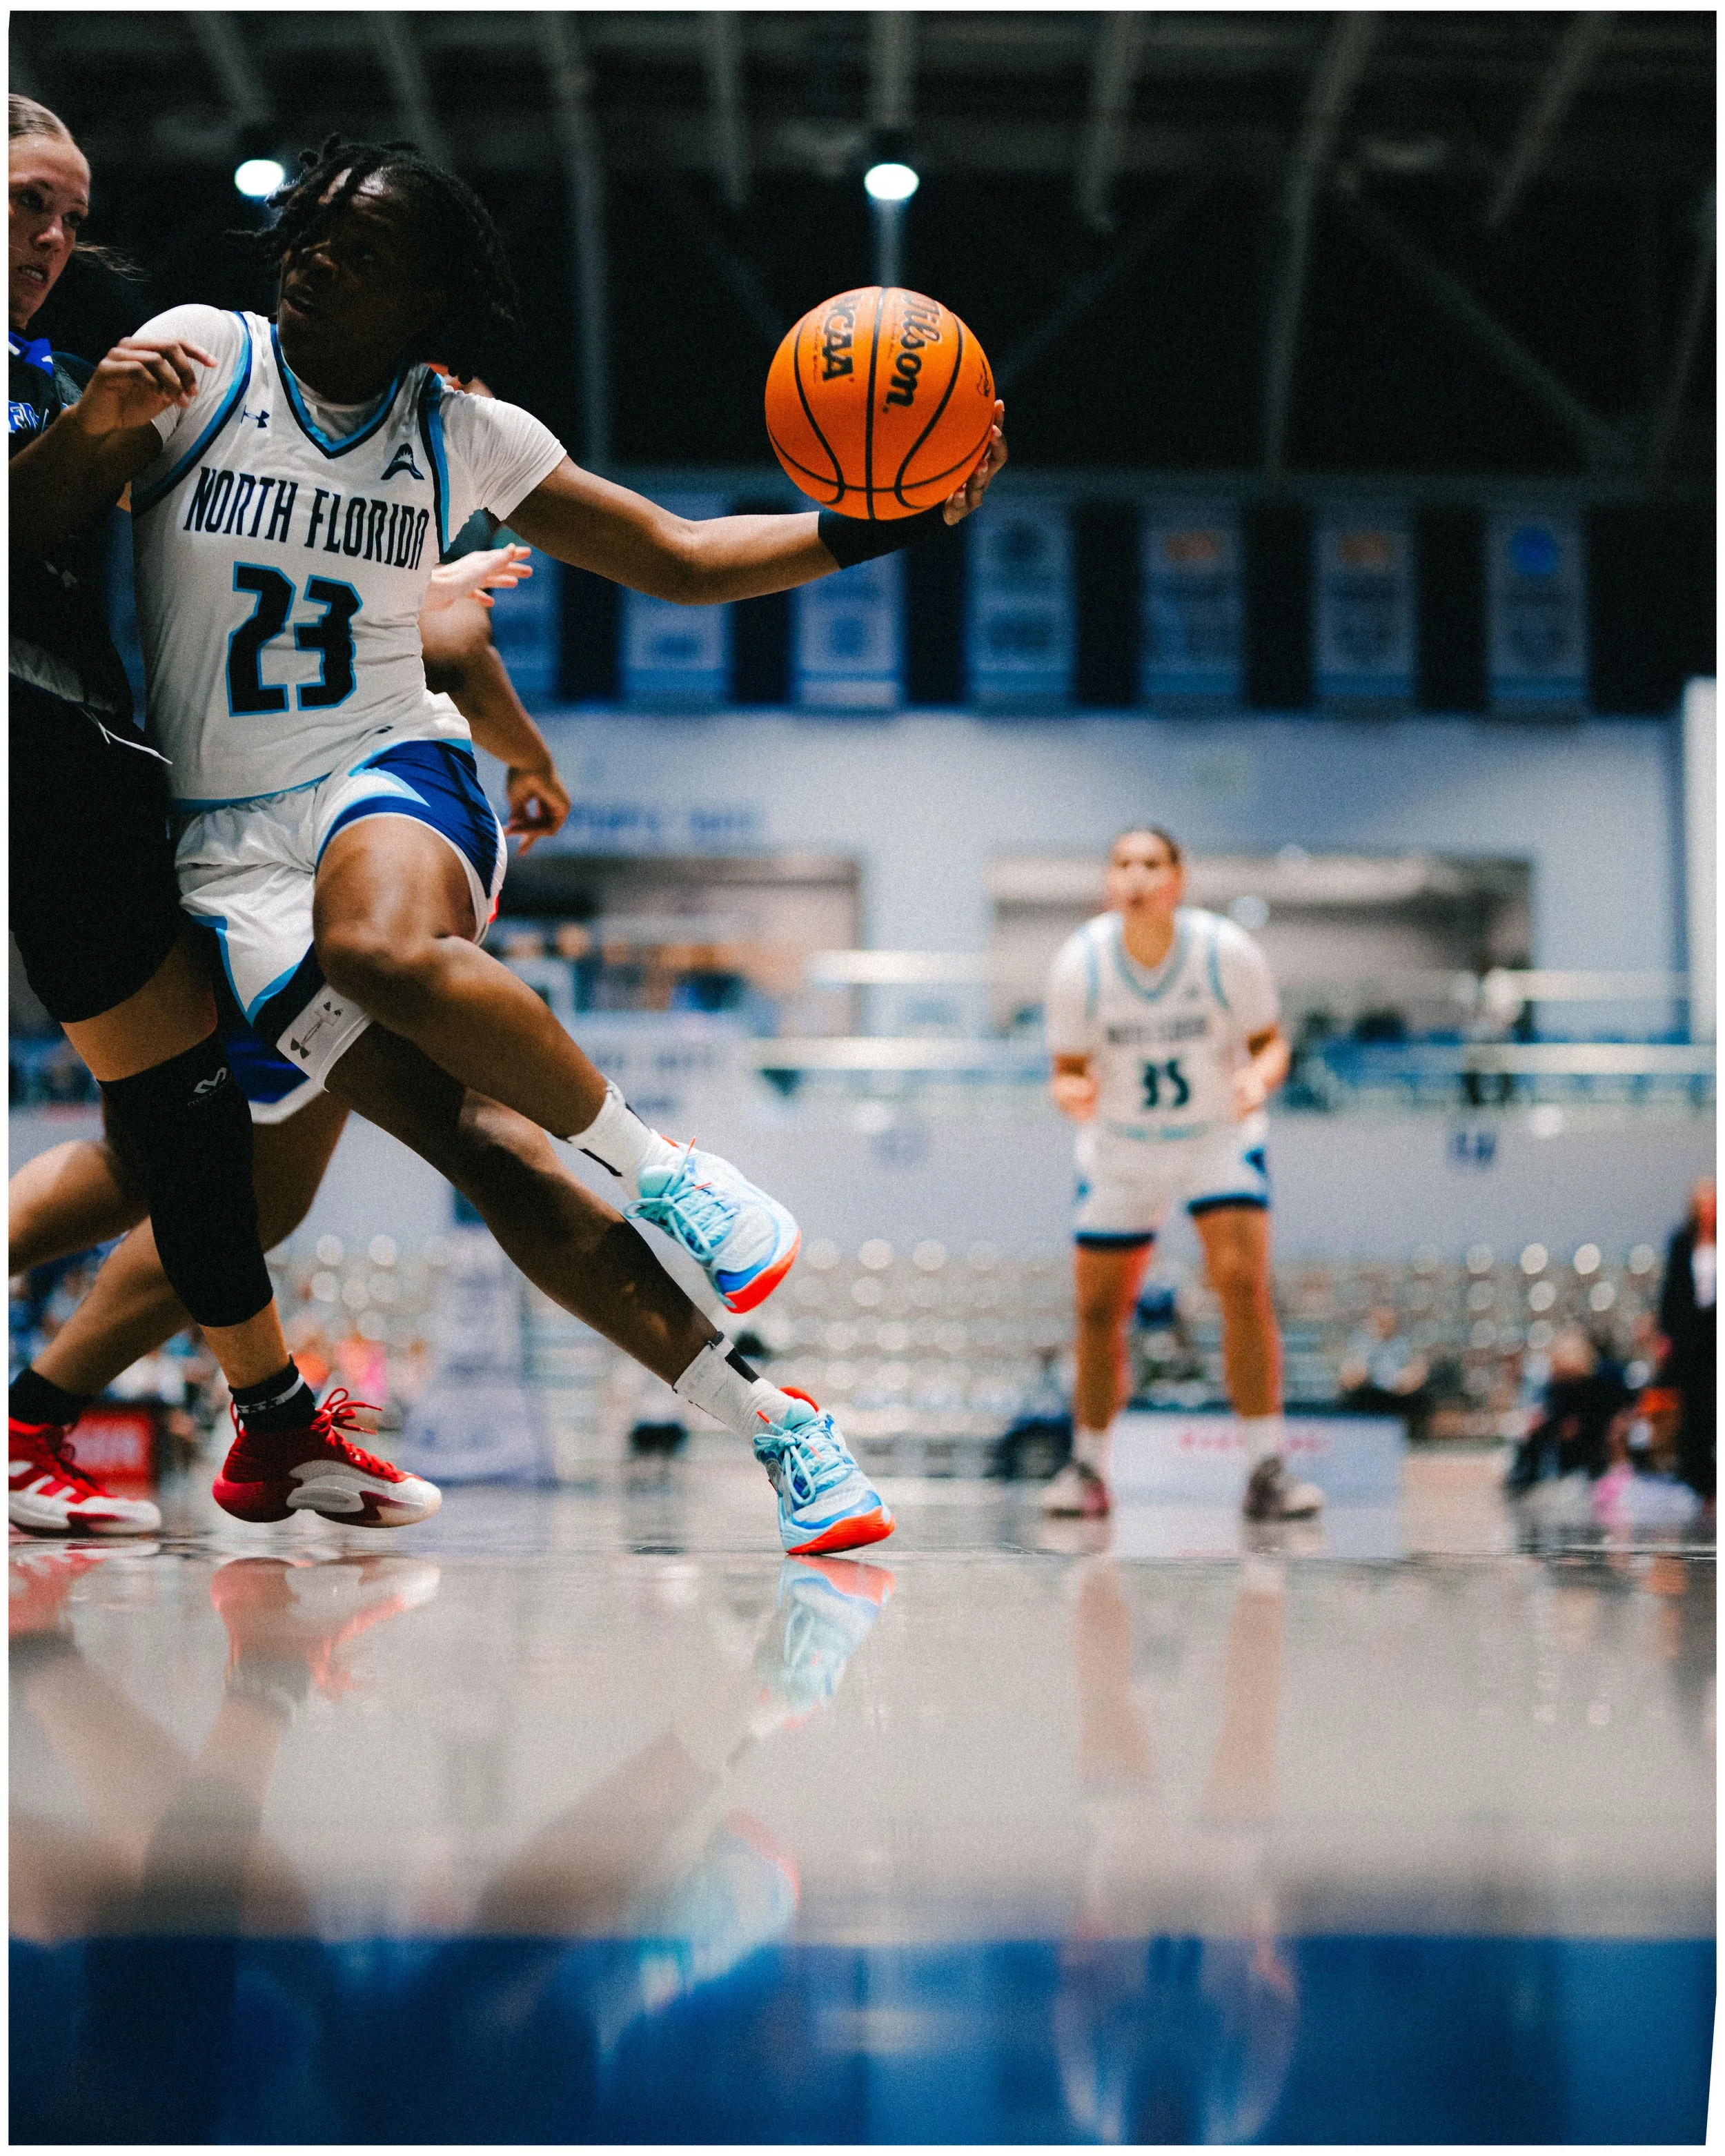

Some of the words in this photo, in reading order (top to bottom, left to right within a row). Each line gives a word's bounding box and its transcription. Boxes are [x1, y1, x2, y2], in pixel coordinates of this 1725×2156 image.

[183, 466, 299, 543] NORTH
[304, 488, 430, 571] FLORIDA
[225, 560, 364, 718] 23
